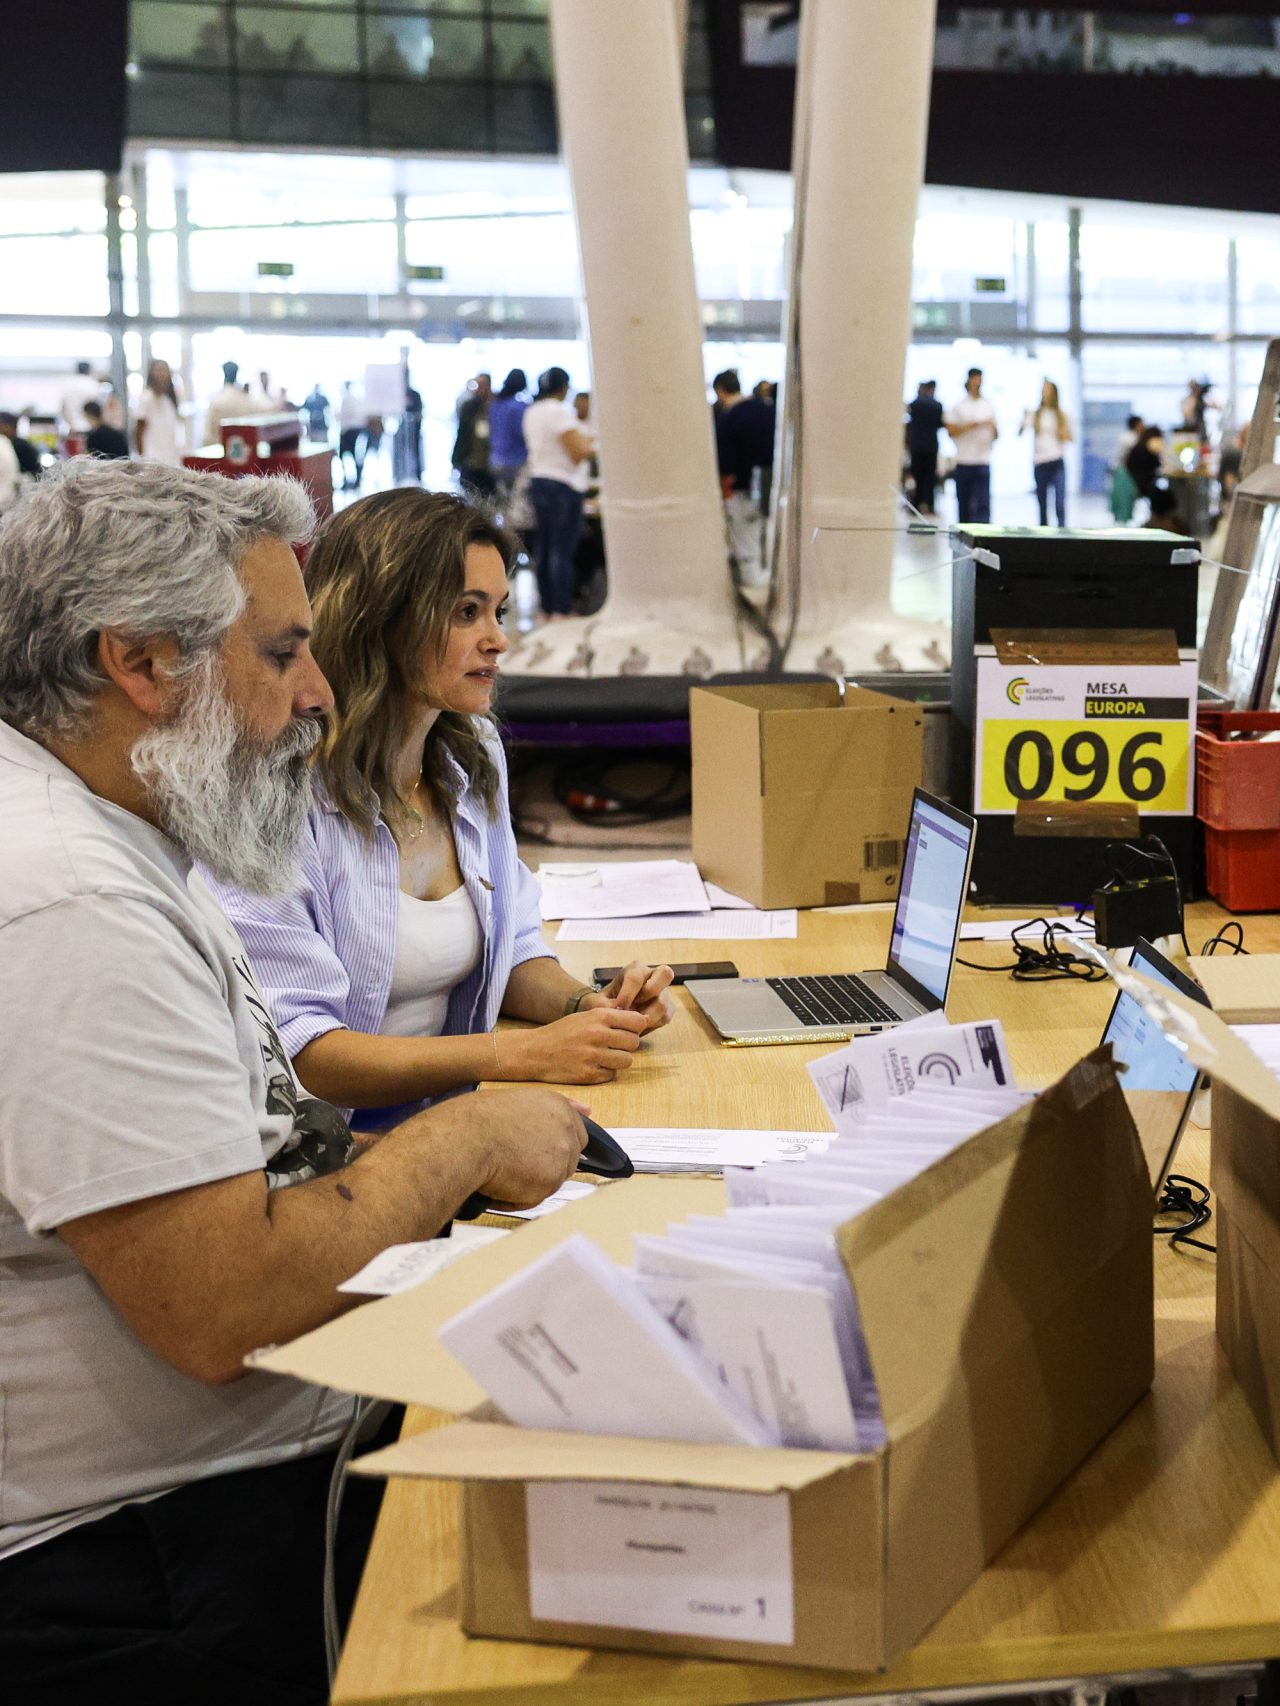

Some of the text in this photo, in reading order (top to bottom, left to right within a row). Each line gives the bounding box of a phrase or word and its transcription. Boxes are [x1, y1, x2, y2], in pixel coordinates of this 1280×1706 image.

[1086, 682, 1128, 695] MESA
[1085, 701, 1146, 715] EUROPA
[1003, 730, 1166, 801] 096
[757, 1597, 767, 1619] 1
